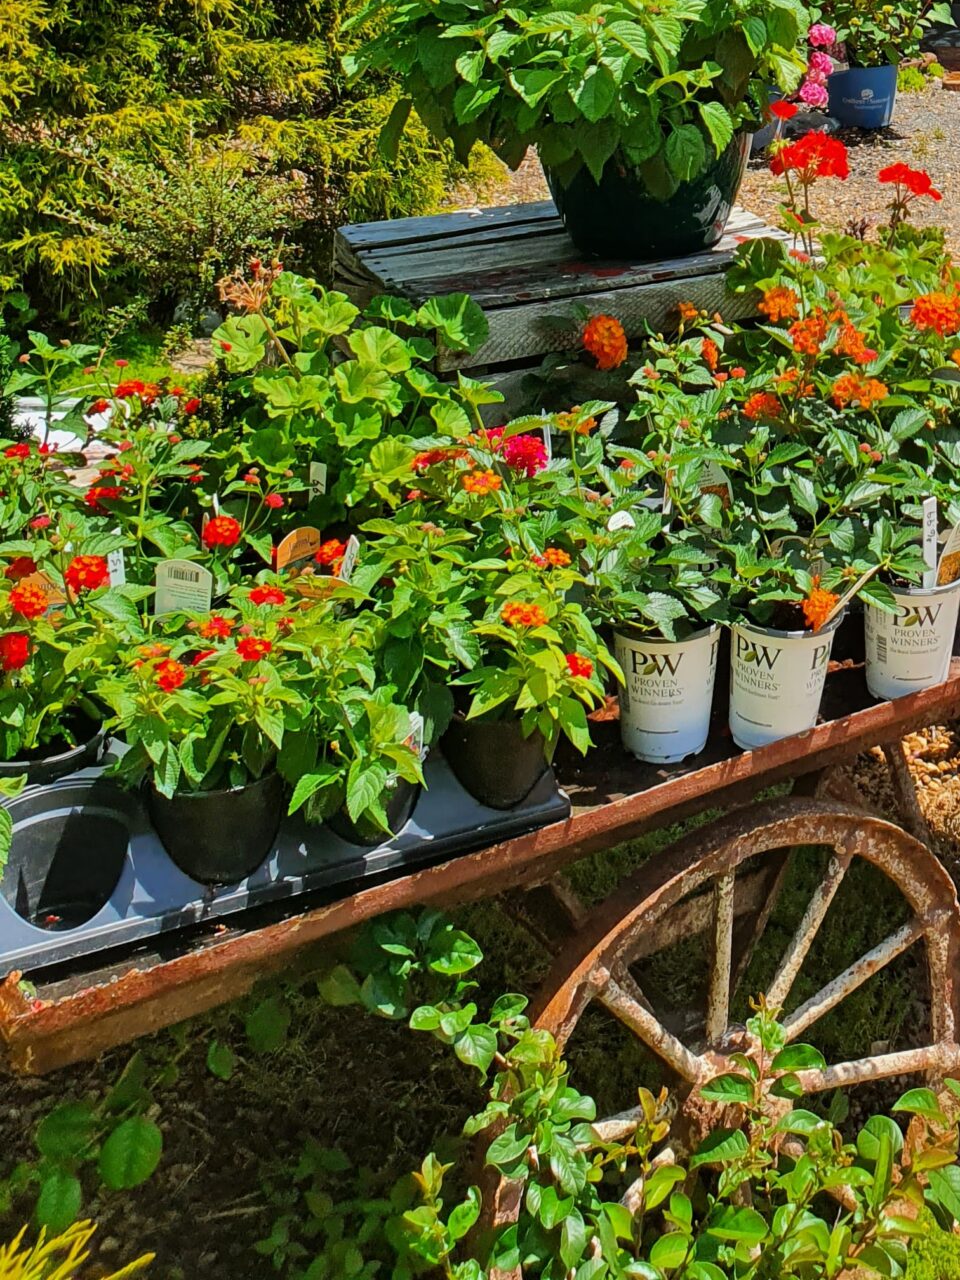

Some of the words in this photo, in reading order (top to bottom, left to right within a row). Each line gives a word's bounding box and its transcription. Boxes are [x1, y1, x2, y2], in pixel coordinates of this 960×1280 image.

[892, 602, 943, 627] PW
[890, 636, 939, 647] WINNERS
[894, 628, 936, 639] PROVEN
[737, 633, 783, 671] PW
[630, 648, 685, 677] PW
[737, 661, 775, 681] PROVEN
[634, 676, 678, 688] PROVEN
[735, 668, 780, 692] WINNERS
[631, 684, 683, 698] WINNERS
